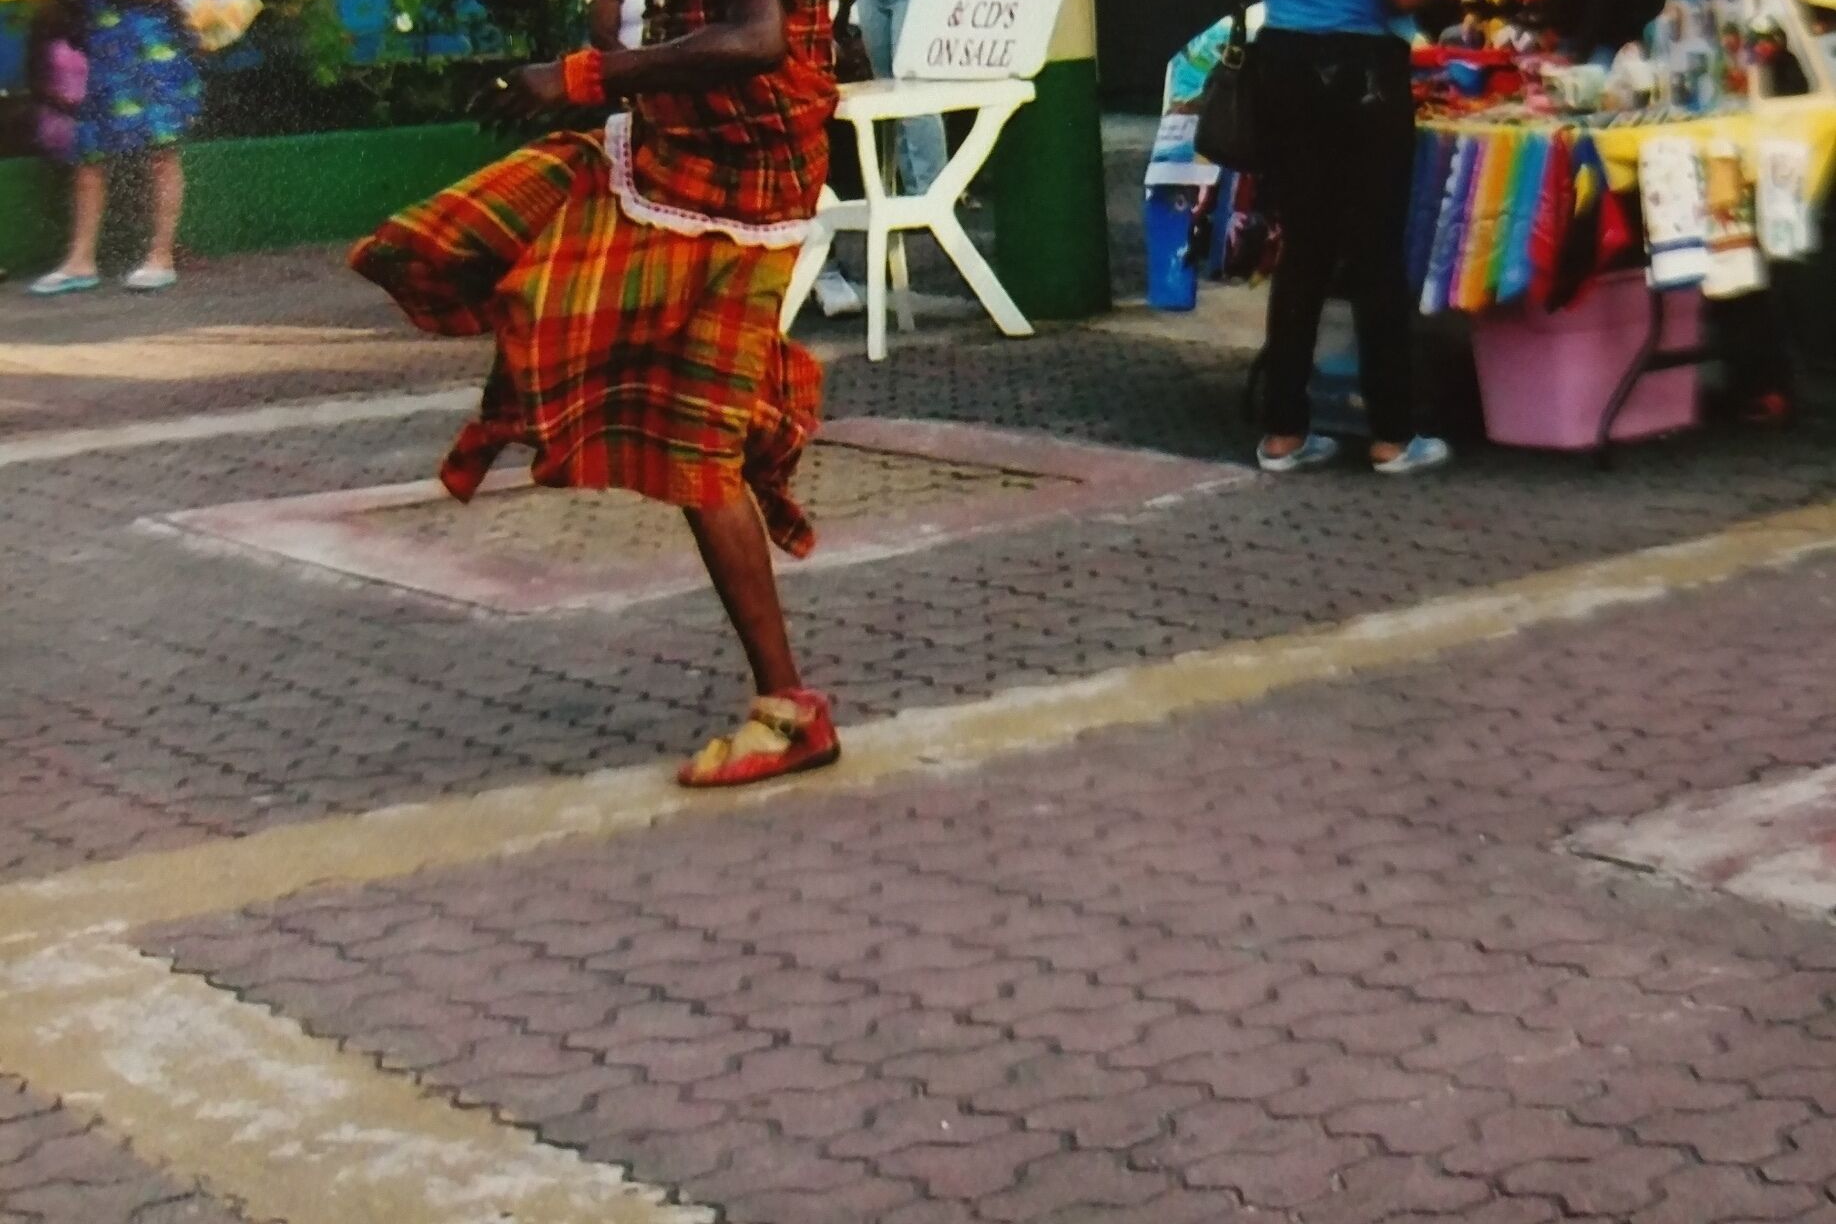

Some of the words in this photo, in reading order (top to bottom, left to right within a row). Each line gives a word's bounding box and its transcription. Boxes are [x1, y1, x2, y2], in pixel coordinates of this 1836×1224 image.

[947, 0, 966, 27] &
[926, 37, 959, 67] ON
[959, 39, 1017, 68] SALE
